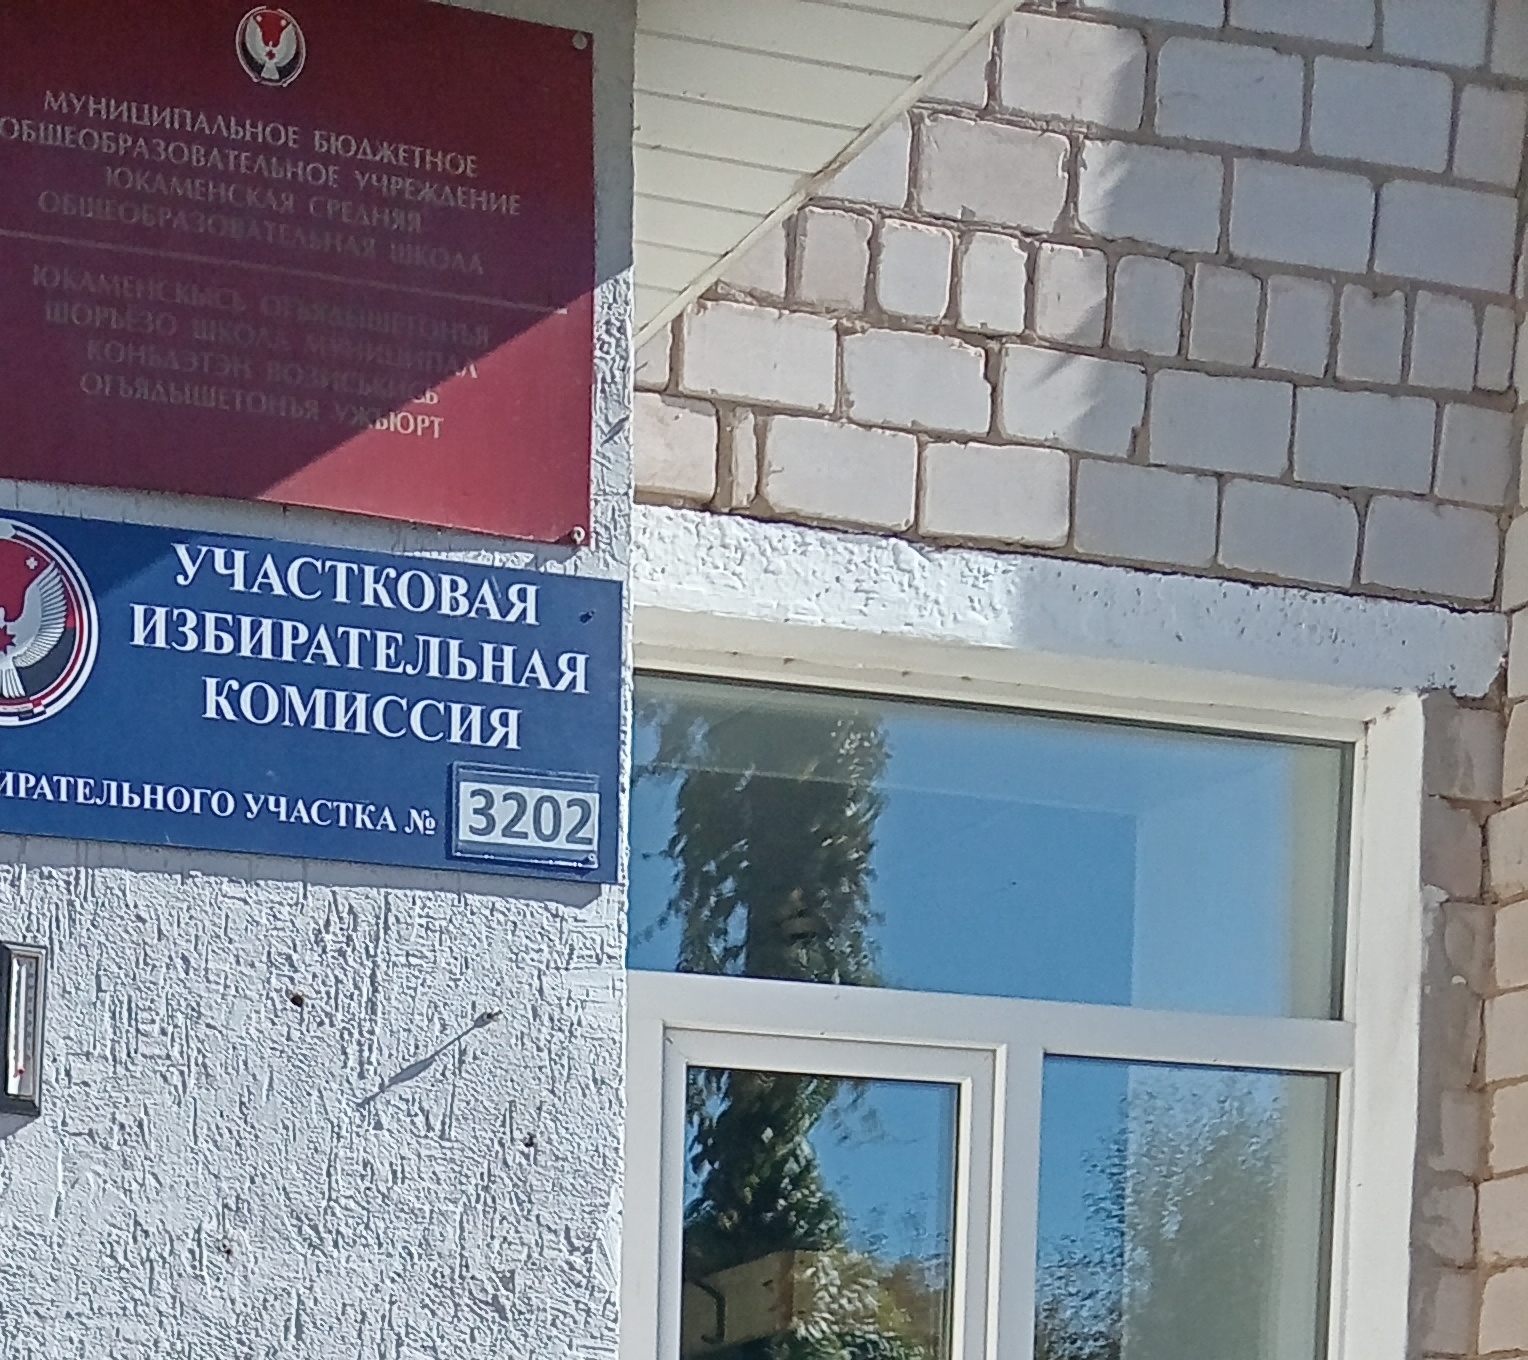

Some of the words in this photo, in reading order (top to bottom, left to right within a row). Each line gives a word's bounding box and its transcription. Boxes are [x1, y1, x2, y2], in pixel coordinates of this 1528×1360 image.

[43, 90, 299, 149] МУНИЦИПАЛЬНОЕ
[313, 129, 478, 178] БЮДЖЕТНОЕ
[38, 190, 376, 260] ОБЩЕОБРАЗОВАТЕЛЬНАЯ
[390, 243, 484, 276] ШКОЛА
[105, 165, 295, 216] ЮКАМЕНСКАЯ
[308, 196, 423, 234] СРЕДНЯЯ
[356, 173, 522, 217] УЧРЕЖДЕНИЕ
[172, 543, 541, 626] УЧАСТКОВАЯ
[130, 603, 589, 695] ИЗБИРАТЕЛЬНАЯ
[202, 677, 522, 750] КОМИССИЯ
[243, 794, 396, 834] УЧАСТКА
[403, 810, 437, 836] №
[468, 788, 594, 847] 3202
